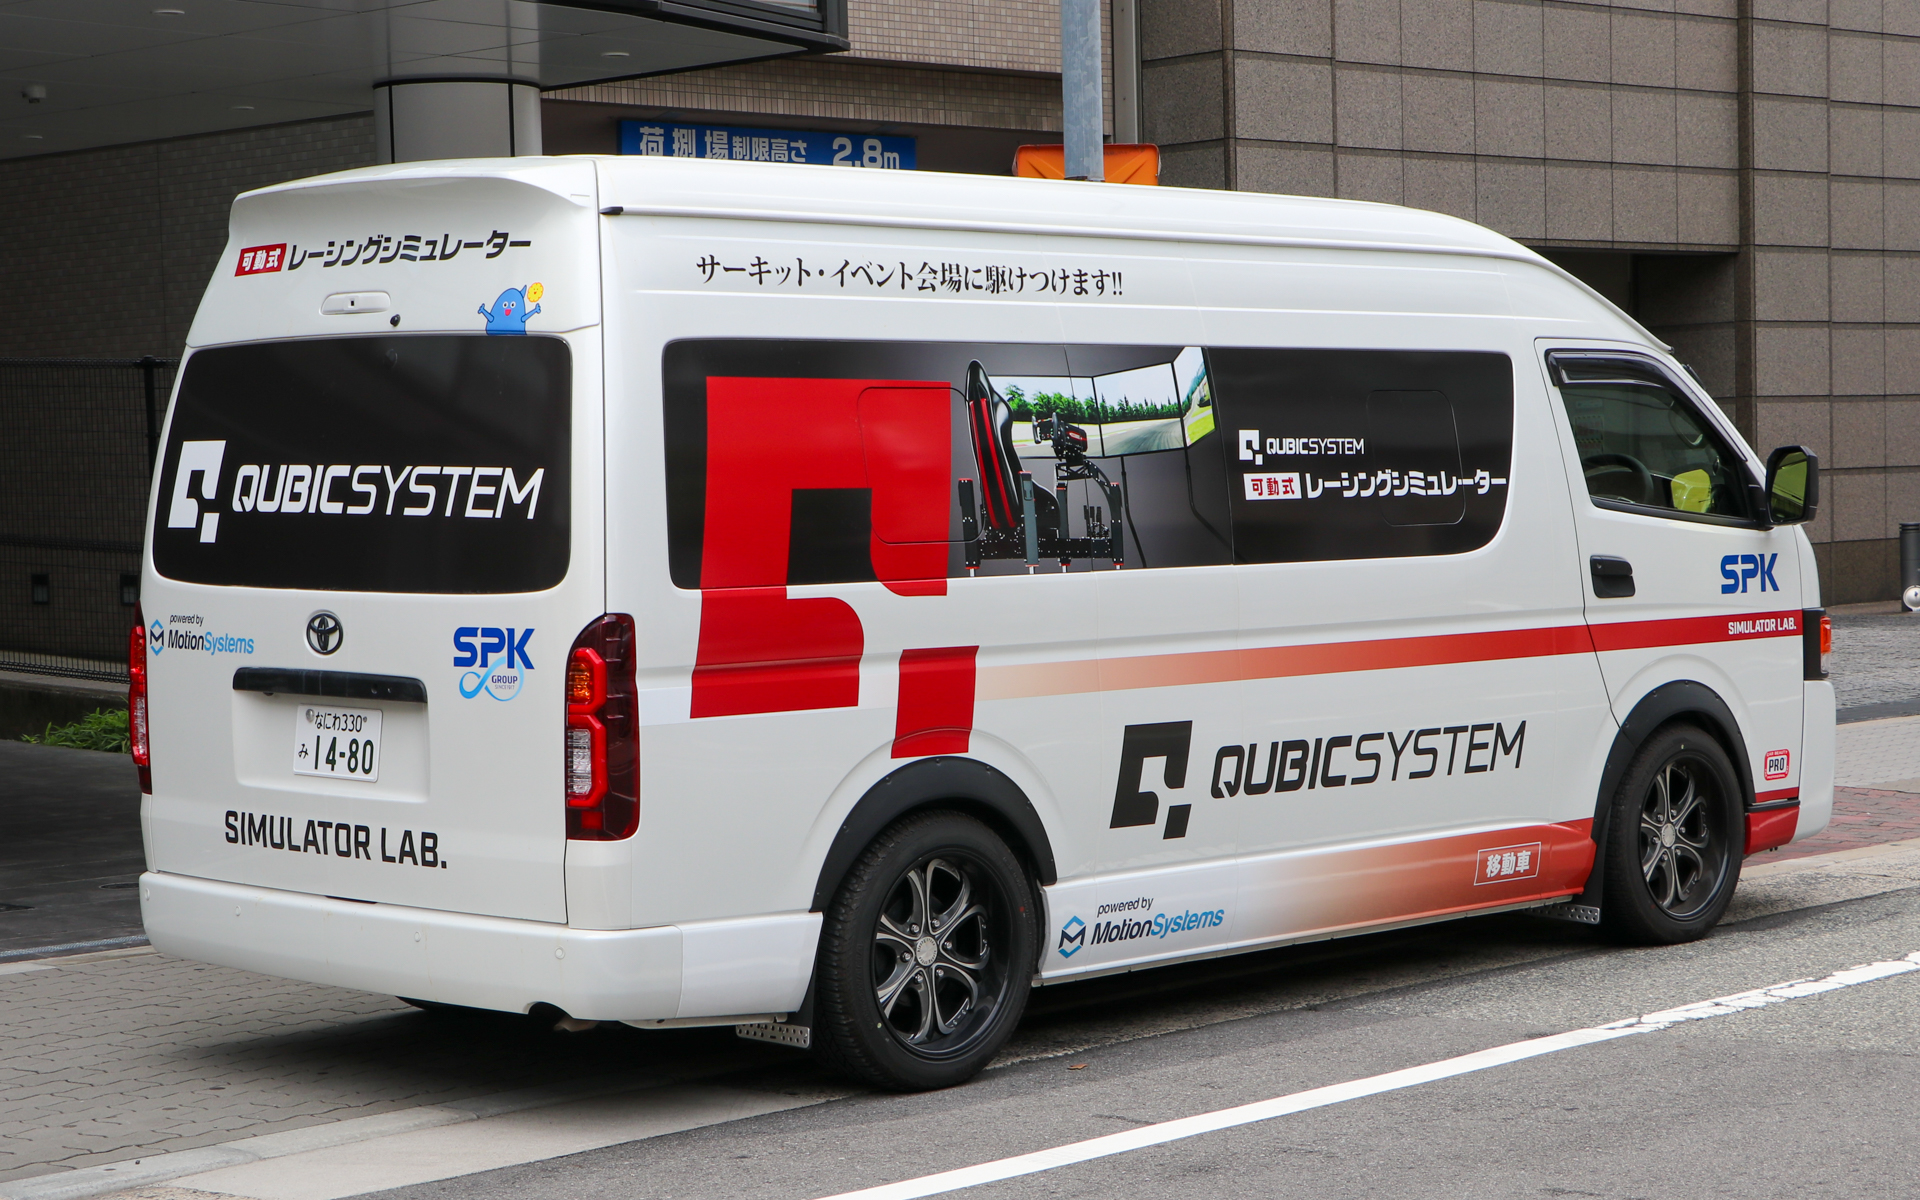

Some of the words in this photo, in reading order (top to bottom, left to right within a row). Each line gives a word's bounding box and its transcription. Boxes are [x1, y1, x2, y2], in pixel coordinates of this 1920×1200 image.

[832, 137, 900, 169] 2.8m
[242, 248, 282, 271] 可動式
[287, 230, 532, 270] レーシングシミュレーター
[1266, 438, 1365, 455] QUBICSYSTEM
[231, 464, 545, 520] QUBICSYSTEM
[1250, 477, 1296, 496] 可動式
[1305, 469, 1507, 499] レーシングシミュレーター
[1720, 553, 1780, 594] SPK
[169, 614, 195, 625] powered
[195, 614, 204, 627] by
[1728, 619, 1776, 635] SIMULATOR
[1777, 617, 1797, 631] LAB.
[168, 629, 255, 656] MotionSystems
[453, 626, 536, 670] SPK
[491, 675, 519, 685] GROUP
[298, 743, 309, 760] み
[314, 735, 375, 775] 14-80
[1210, 720, 1527, 799] QUBICSYSTEM
[1768, 757, 1785, 773] PRO
[224, 810, 372, 861] SIMULATOR
[381, 827, 448, 869] LAB.
[1485, 850, 1532, 878] 移動車
[1096, 897, 1140, 918] powered
[1140, 897, 1154, 912] by
[1090, 909, 1225, 946] MotionSystems
